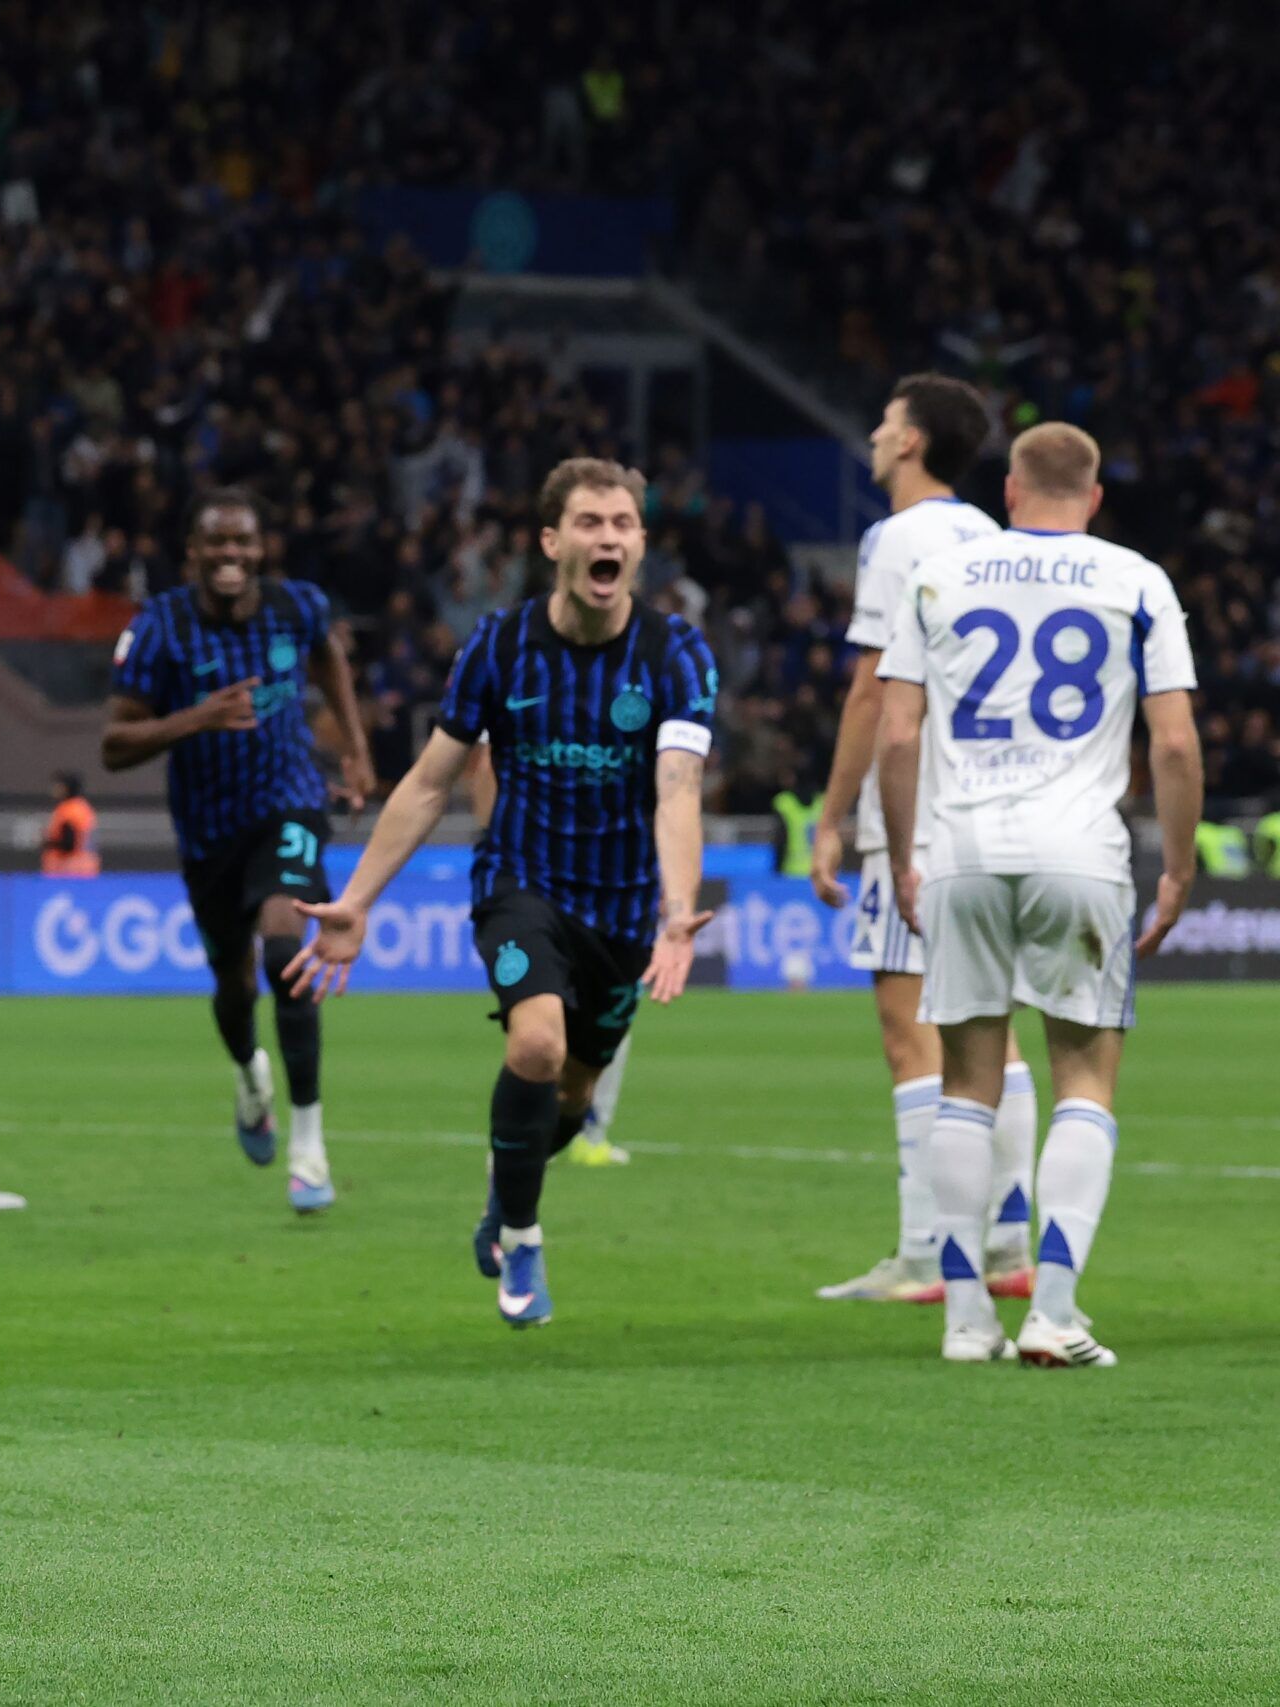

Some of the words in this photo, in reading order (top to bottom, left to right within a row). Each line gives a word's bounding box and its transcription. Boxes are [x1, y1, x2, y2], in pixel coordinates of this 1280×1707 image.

[964, 555, 1099, 588] SMOLČIĆ
[951, 608, 1110, 741] 28
[276, 821, 318, 868] 31
